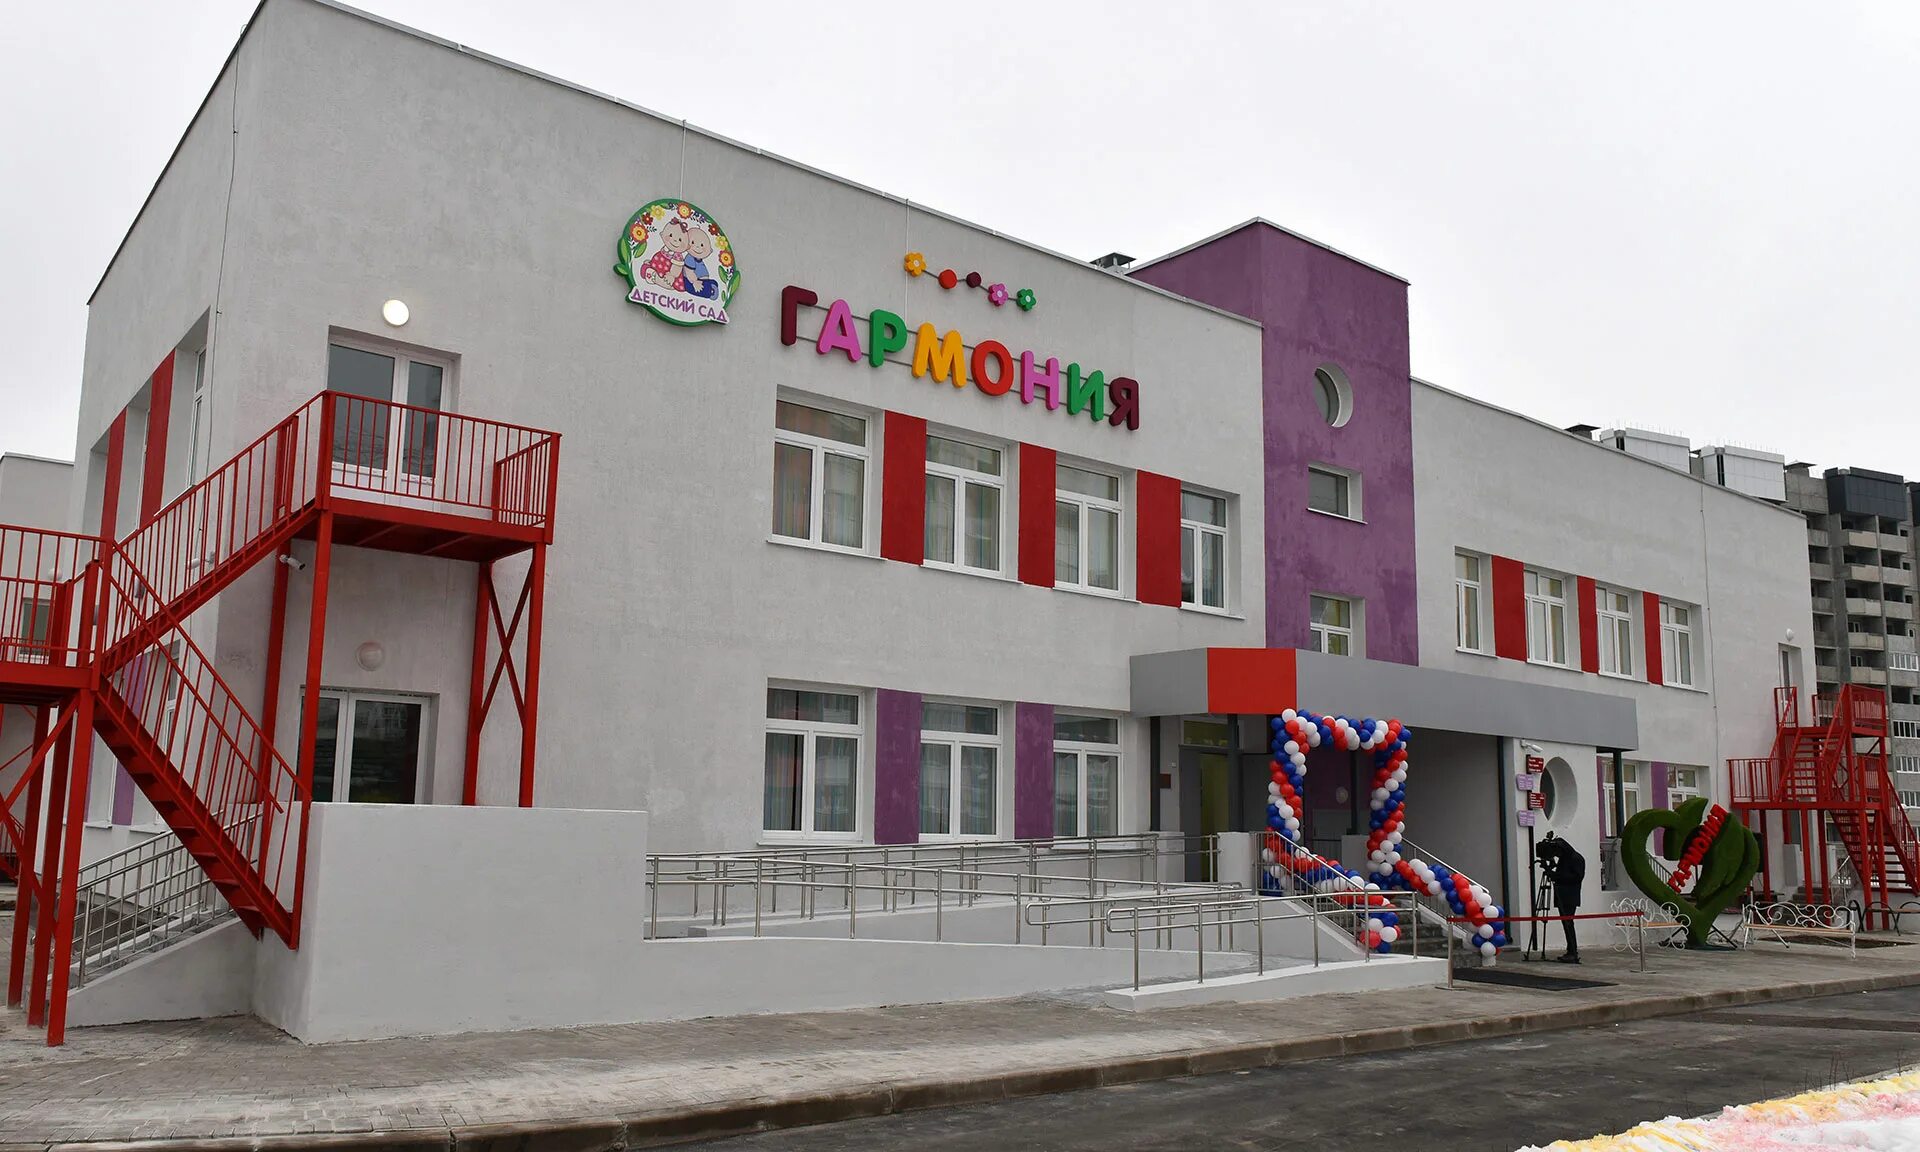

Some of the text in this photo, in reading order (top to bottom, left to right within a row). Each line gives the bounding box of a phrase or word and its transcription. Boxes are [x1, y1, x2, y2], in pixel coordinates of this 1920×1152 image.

[631, 289, 728, 322] ДЕТСКИЙ САД
[781, 285, 1140, 431] ГАРМОНИЯ
[1667, 804, 1729, 894] ГАРМОНИЯ
